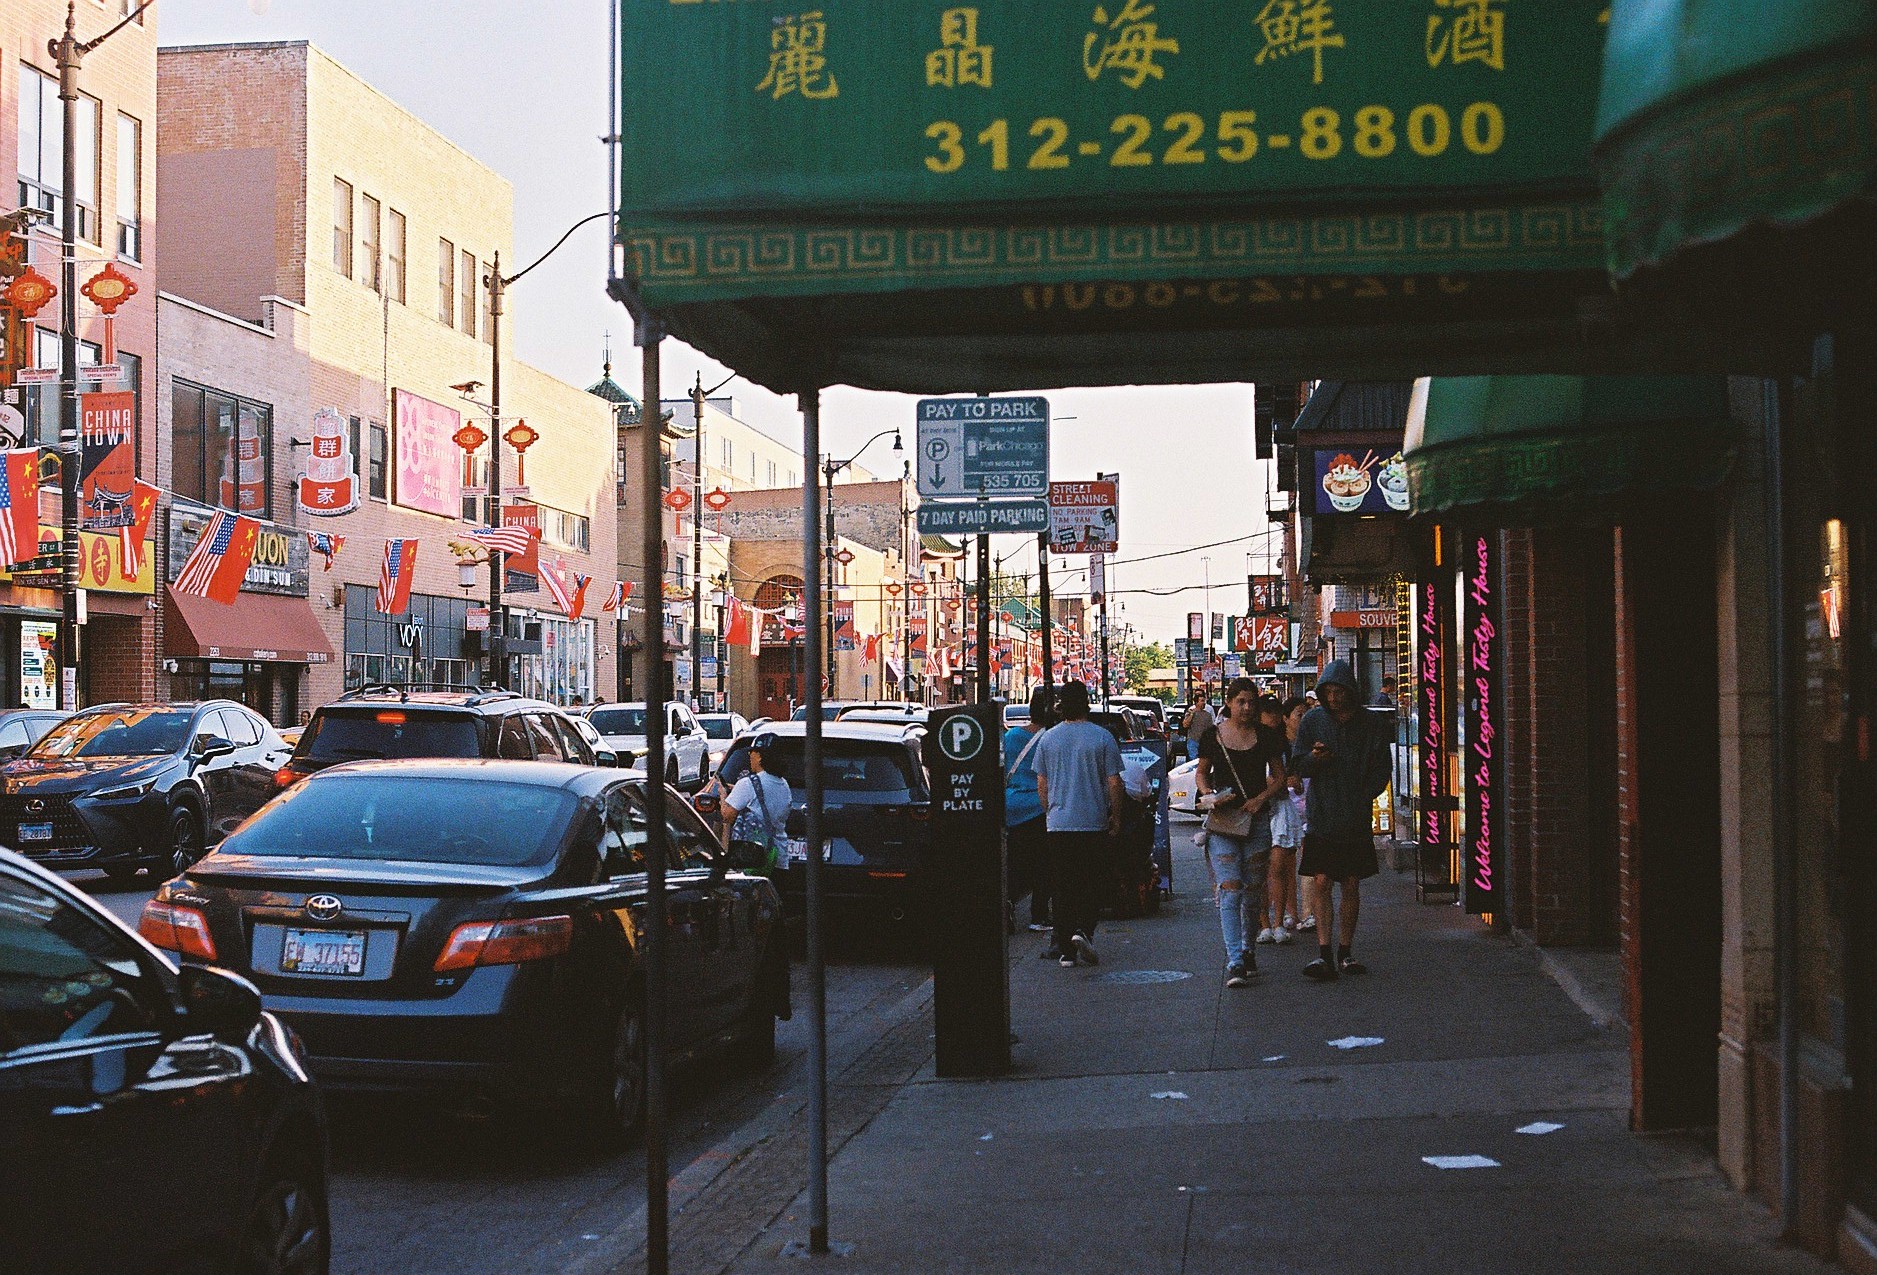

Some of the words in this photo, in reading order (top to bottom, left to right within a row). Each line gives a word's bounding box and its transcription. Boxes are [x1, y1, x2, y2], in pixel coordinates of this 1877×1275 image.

[754, 0, 1504, 100] 麗晶海鮮酒
[924, 102, 1505, 173] 312-225-8800
[85, 409, 131, 428] CHINA
[926, 404, 957, 418] PAY
[961, 403, 986, 417] TO
[990, 401, 1037, 416] PARK
[85, 427, 131, 446] TOWN
[983, 475, 1009, 487] 535
[1014, 474, 1040, 486] 705
[1052, 484, 1092, 494] STREET
[1052, 494, 1108, 504] CLEANING
[505, 516, 536, 527] CHINA
[920, 512, 929, 525] 7
[932, 511, 955, 525] DAY
[958, 509, 987, 524] PAID
[990, 507, 1045, 524] PARKING
[1054, 543, 1077, 552] TOW
[1083, 542, 1112, 551] ZONE
[253, 569, 270, 583] DIM
[273, 571, 291, 586] SUM
[1471, 537, 1491, 606] House
[1422, 583, 1437, 635] House
[1360, 613, 1398, 626] SOUVE
[1473, 612, 1495, 672] Tasty
[1424, 639, 1440, 683] Tasty
[1473, 676, 1495, 759] Legend
[952, 722, 972, 753] P
[1425, 750, 1437, 769] to
[950, 774, 974, 785] PAY
[1474, 760, 1490, 788] to
[954, 788, 970, 798] BY
[943, 800, 983, 811] PLATE
[1474, 790, 1492, 891] Welcome
